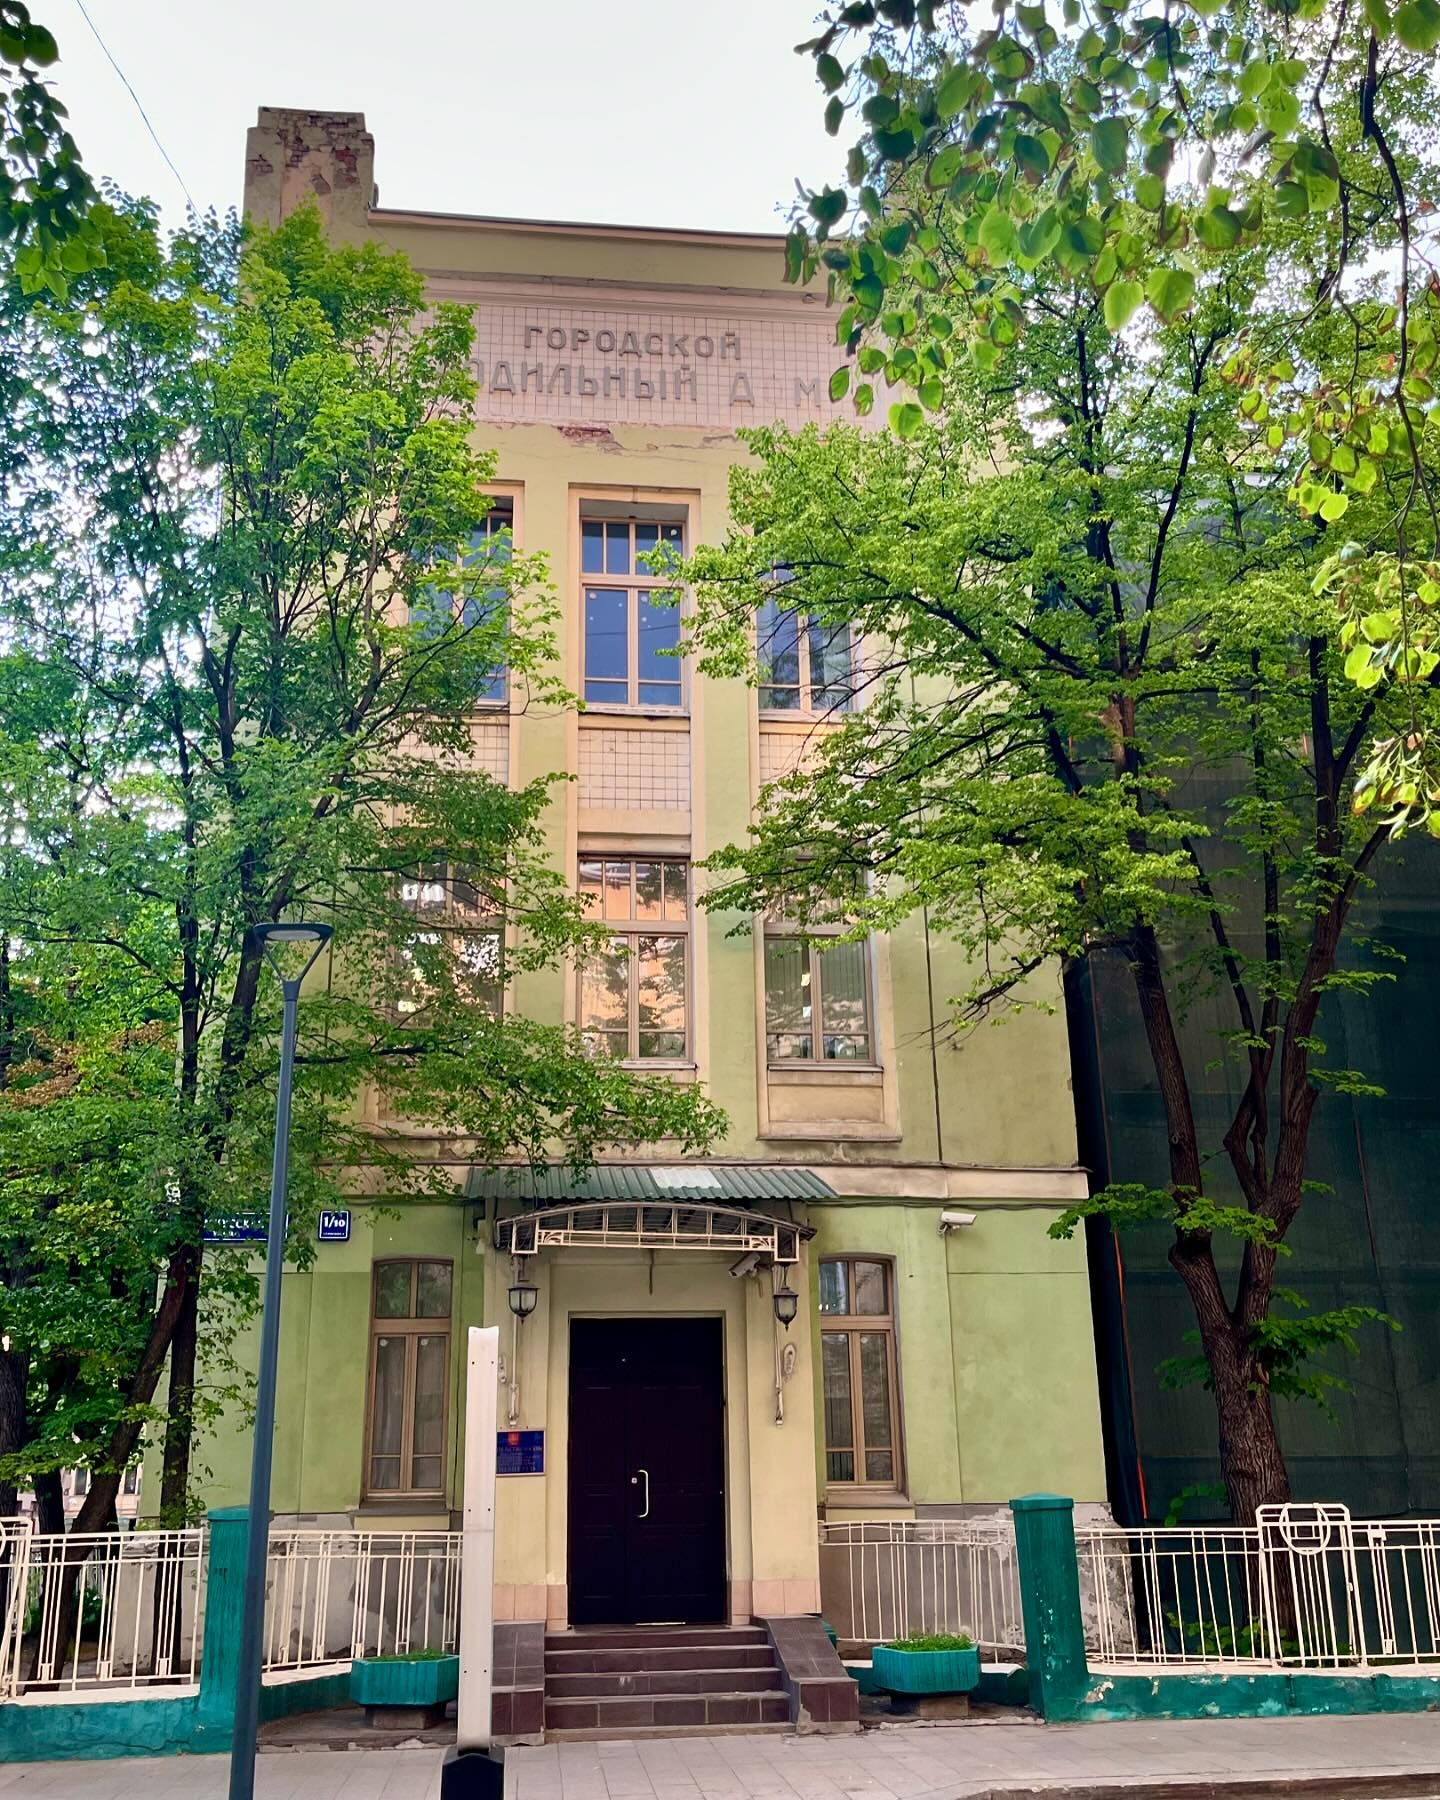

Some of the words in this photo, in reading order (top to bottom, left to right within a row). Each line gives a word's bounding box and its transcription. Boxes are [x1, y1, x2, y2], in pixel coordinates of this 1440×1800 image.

[524, 325, 741, 360] ГОРОДСКОЙ
[464, 358, 697, 401] ОДИЛЬНЫЙ
[323, 1215, 346, 1229] 1/10
